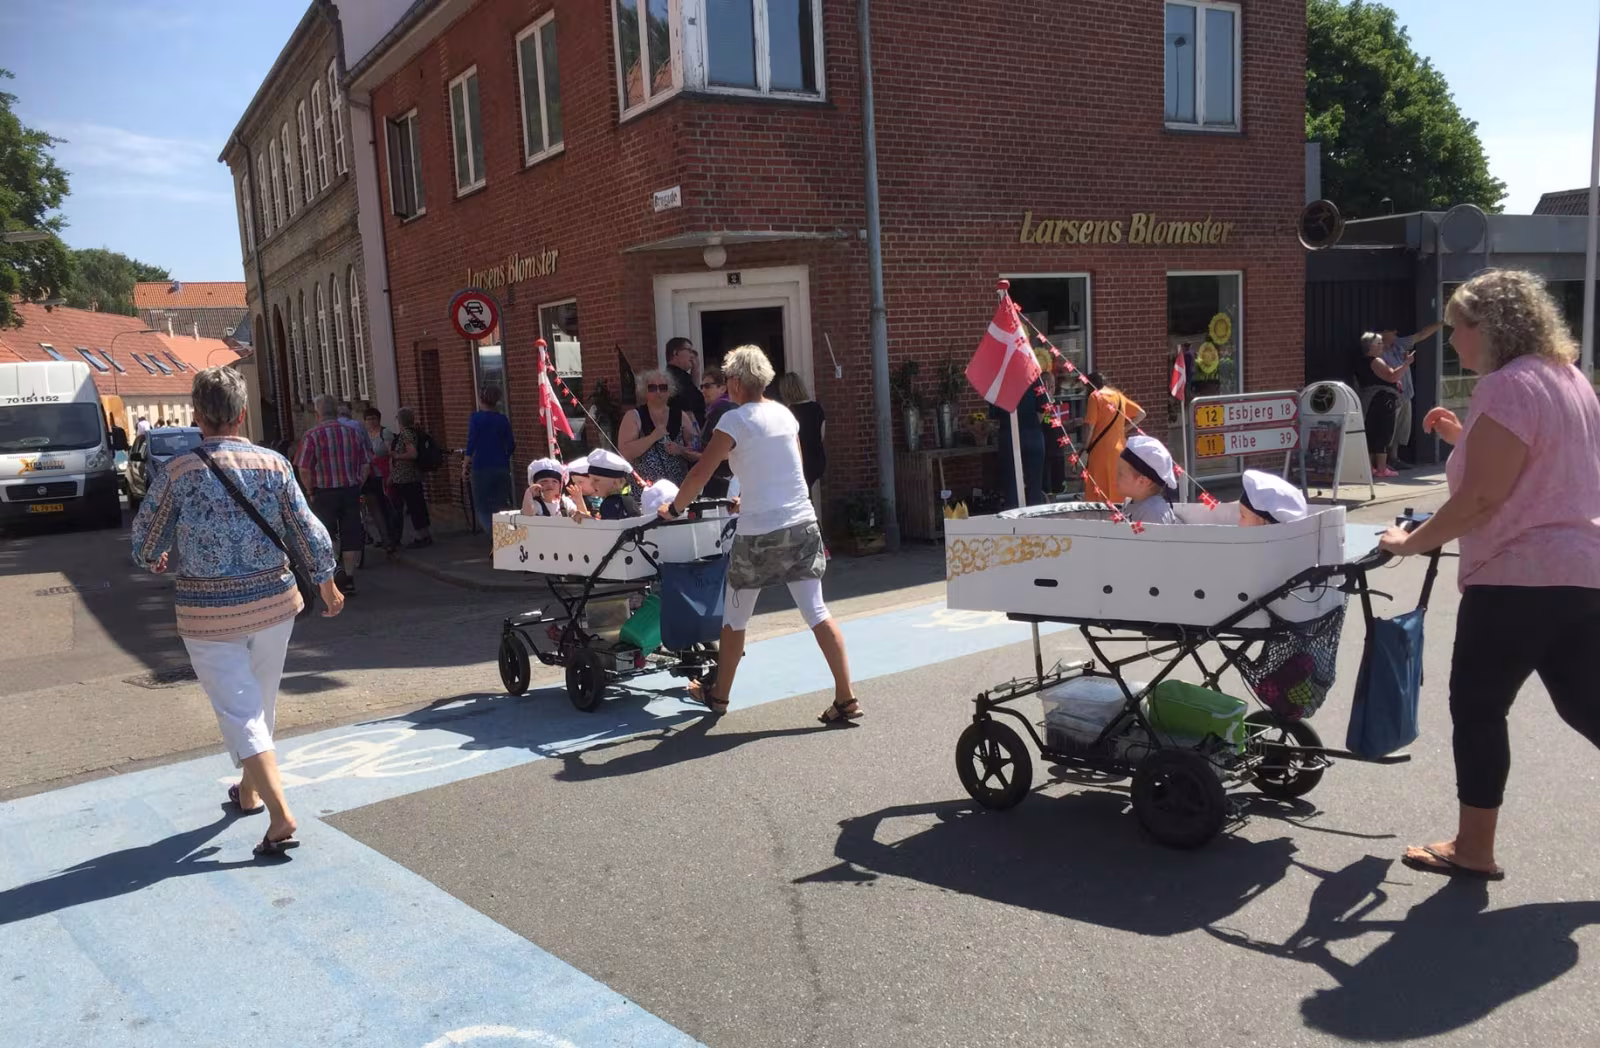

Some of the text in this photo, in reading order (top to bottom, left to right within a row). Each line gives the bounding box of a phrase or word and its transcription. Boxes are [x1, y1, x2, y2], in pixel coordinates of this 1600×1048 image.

[1019, 210, 1234, 244] Larsens Blomster
[508, 246, 559, 284] Blomster
[1205, 402, 1291, 423] 12 Esbjerg 18
[1206, 431, 1292, 451] 11 Ribe 39
